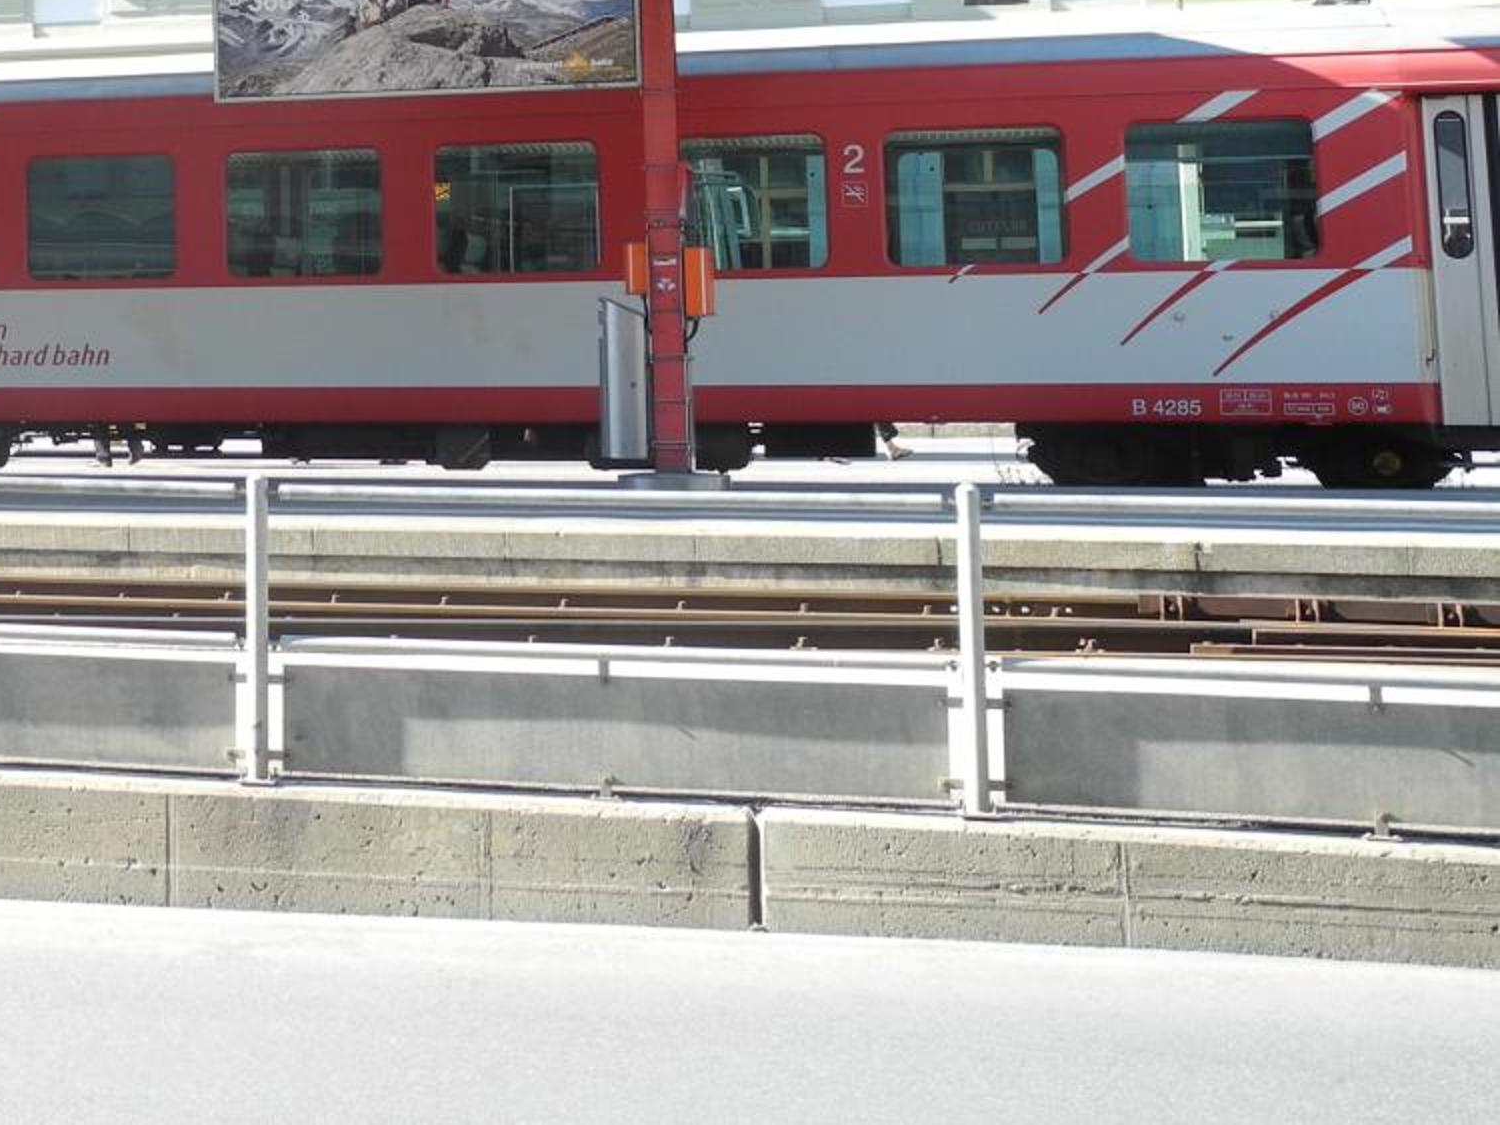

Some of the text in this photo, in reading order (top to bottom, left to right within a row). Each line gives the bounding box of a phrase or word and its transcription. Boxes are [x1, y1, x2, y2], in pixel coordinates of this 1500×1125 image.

[843, 144, 864, 173] 2
[51, 343, 110, 366] bahn
[1132, 398, 1147, 415] B
[1153, 398, 1203, 416] 4285
